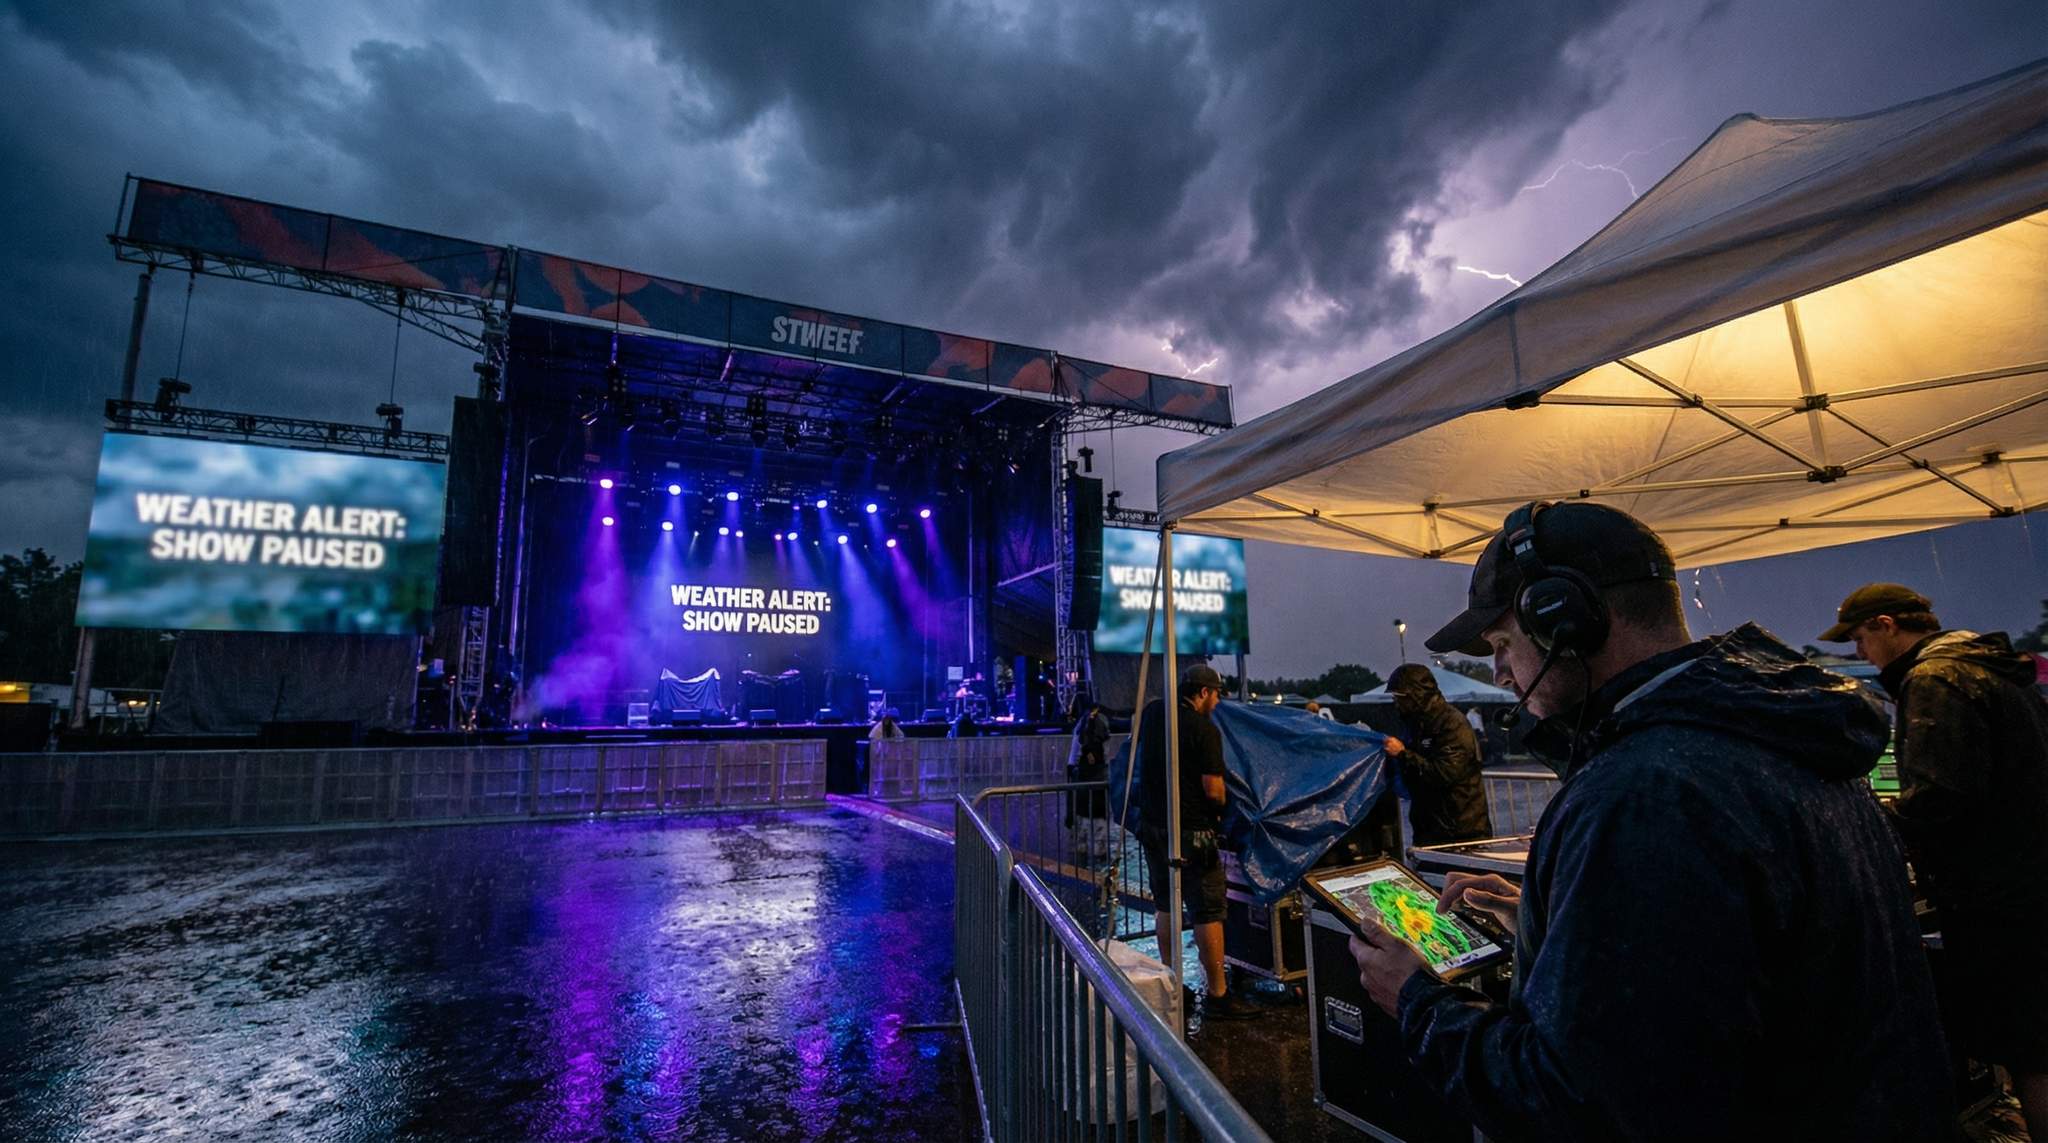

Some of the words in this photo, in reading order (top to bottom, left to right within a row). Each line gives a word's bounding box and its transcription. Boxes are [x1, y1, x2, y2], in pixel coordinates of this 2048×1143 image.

[136, 492, 295, 531] WEATHER
[301, 505, 406, 538] ALERT:
[151, 529, 255, 562] SHOW
[261, 535, 384, 569] PAUSED
[1109, 566, 1181, 588] WEATHR
[1182, 569, 1232, 591] ALERT:
[671, 585, 764, 608] WEATHER
[768, 590, 831, 611] ALERT:
[683, 610, 743, 632] SHOW
[747, 613, 819, 634] PAUSED
